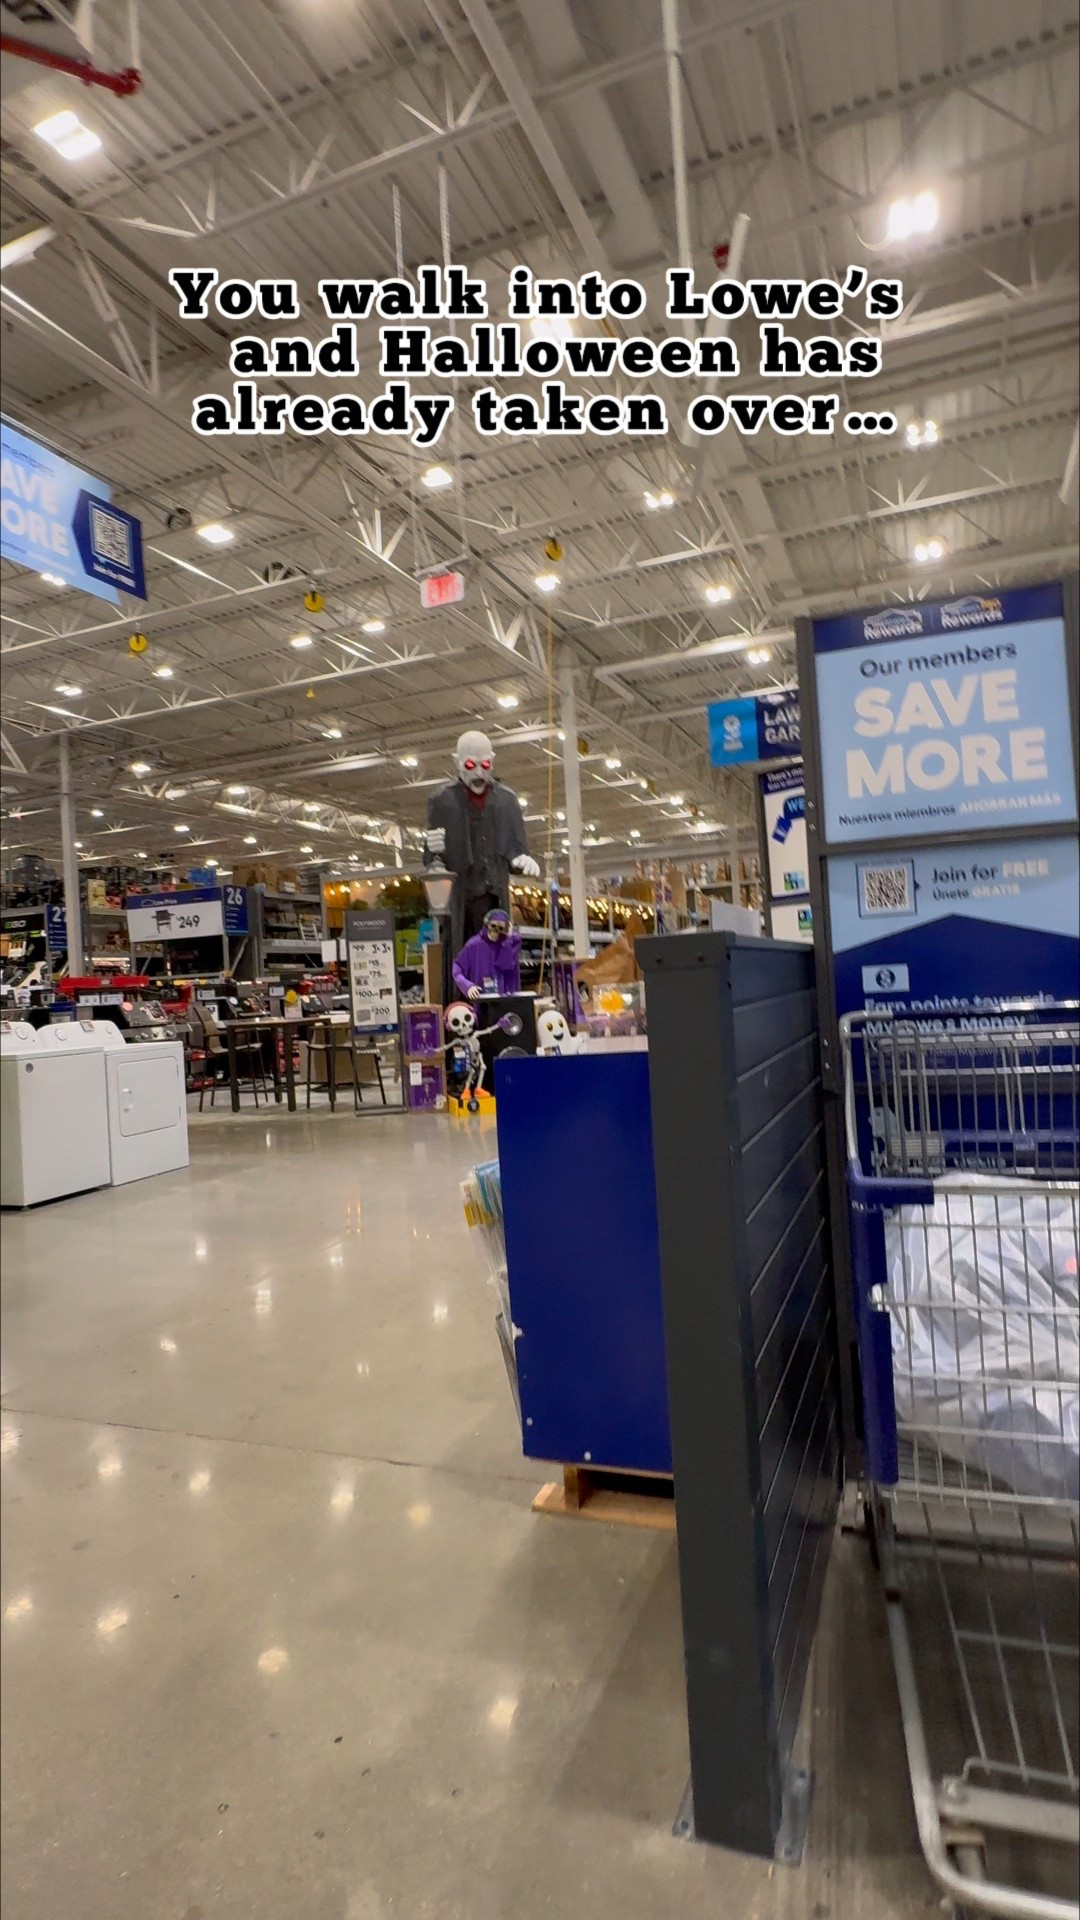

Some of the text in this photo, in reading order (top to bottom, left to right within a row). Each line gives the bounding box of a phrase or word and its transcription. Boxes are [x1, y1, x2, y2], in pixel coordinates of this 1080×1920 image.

[859, 643, 1018, 679] Our members
[853, 668, 1020, 739] SAVE
[845, 727, 1049, 801] MORE
[838, 811, 893, 828] Nuestros
[893, 804, 956, 821] miembros
[931, 857, 1049, 885] Join for FREE
[225, 886, 243, 905] 26
